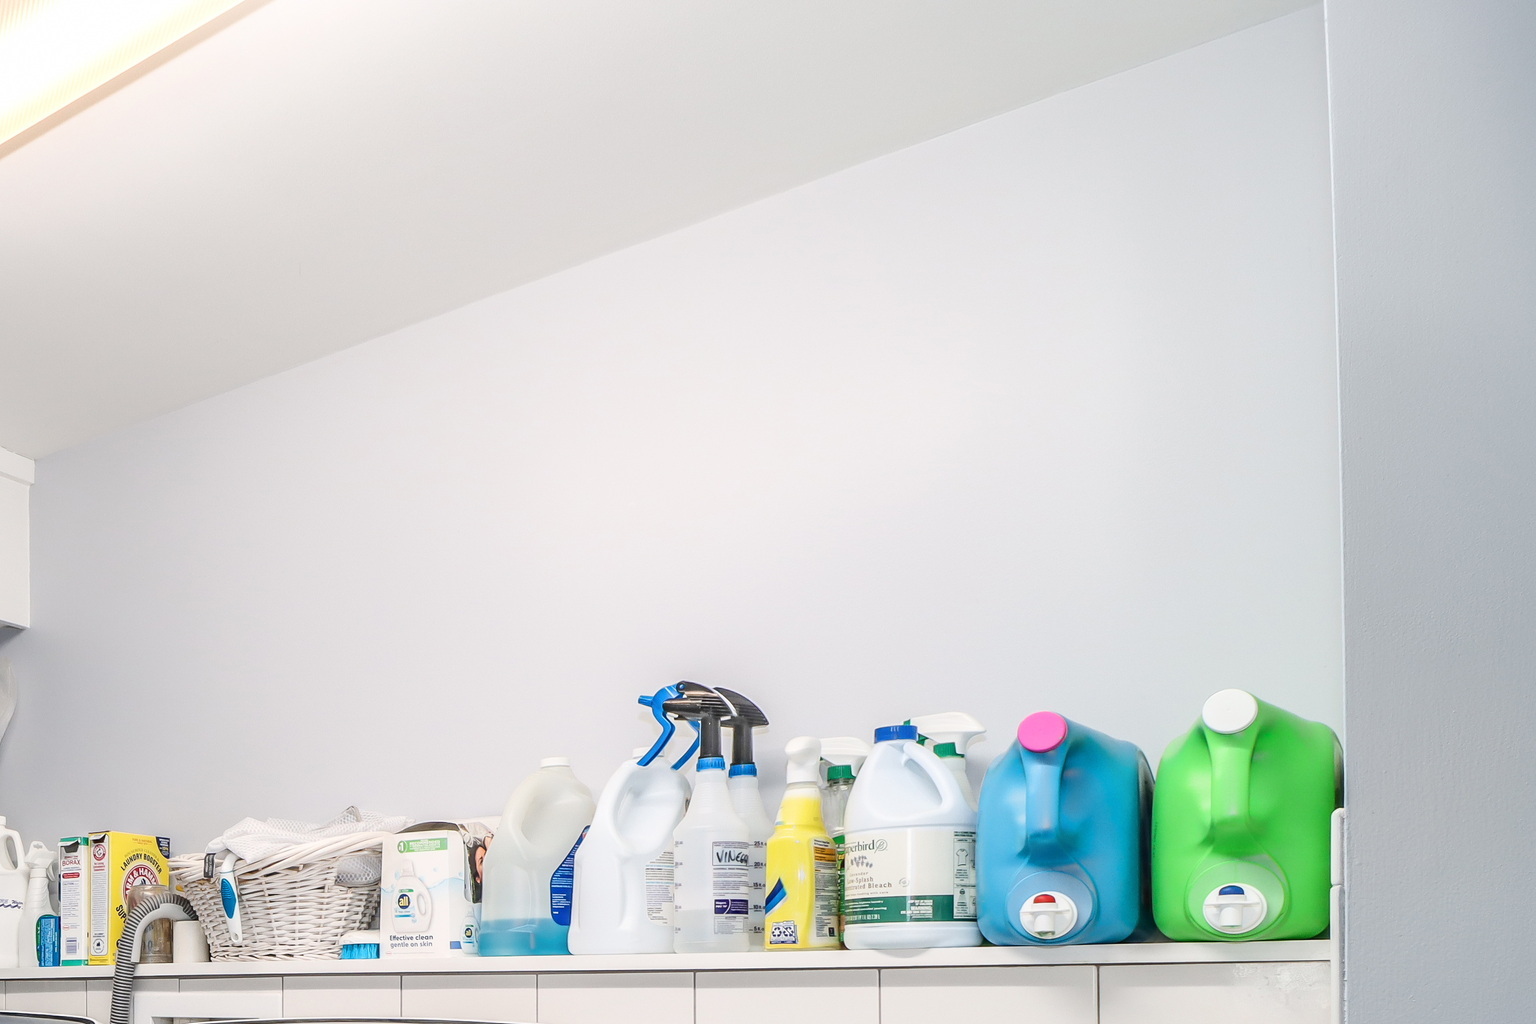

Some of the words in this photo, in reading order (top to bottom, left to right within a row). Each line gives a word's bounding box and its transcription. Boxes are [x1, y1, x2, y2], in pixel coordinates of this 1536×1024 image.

[121, 853, 142, 871] LAUNDRY
[144, 853, 162, 874] BOOSTER
[399, 896, 408, 906] all
